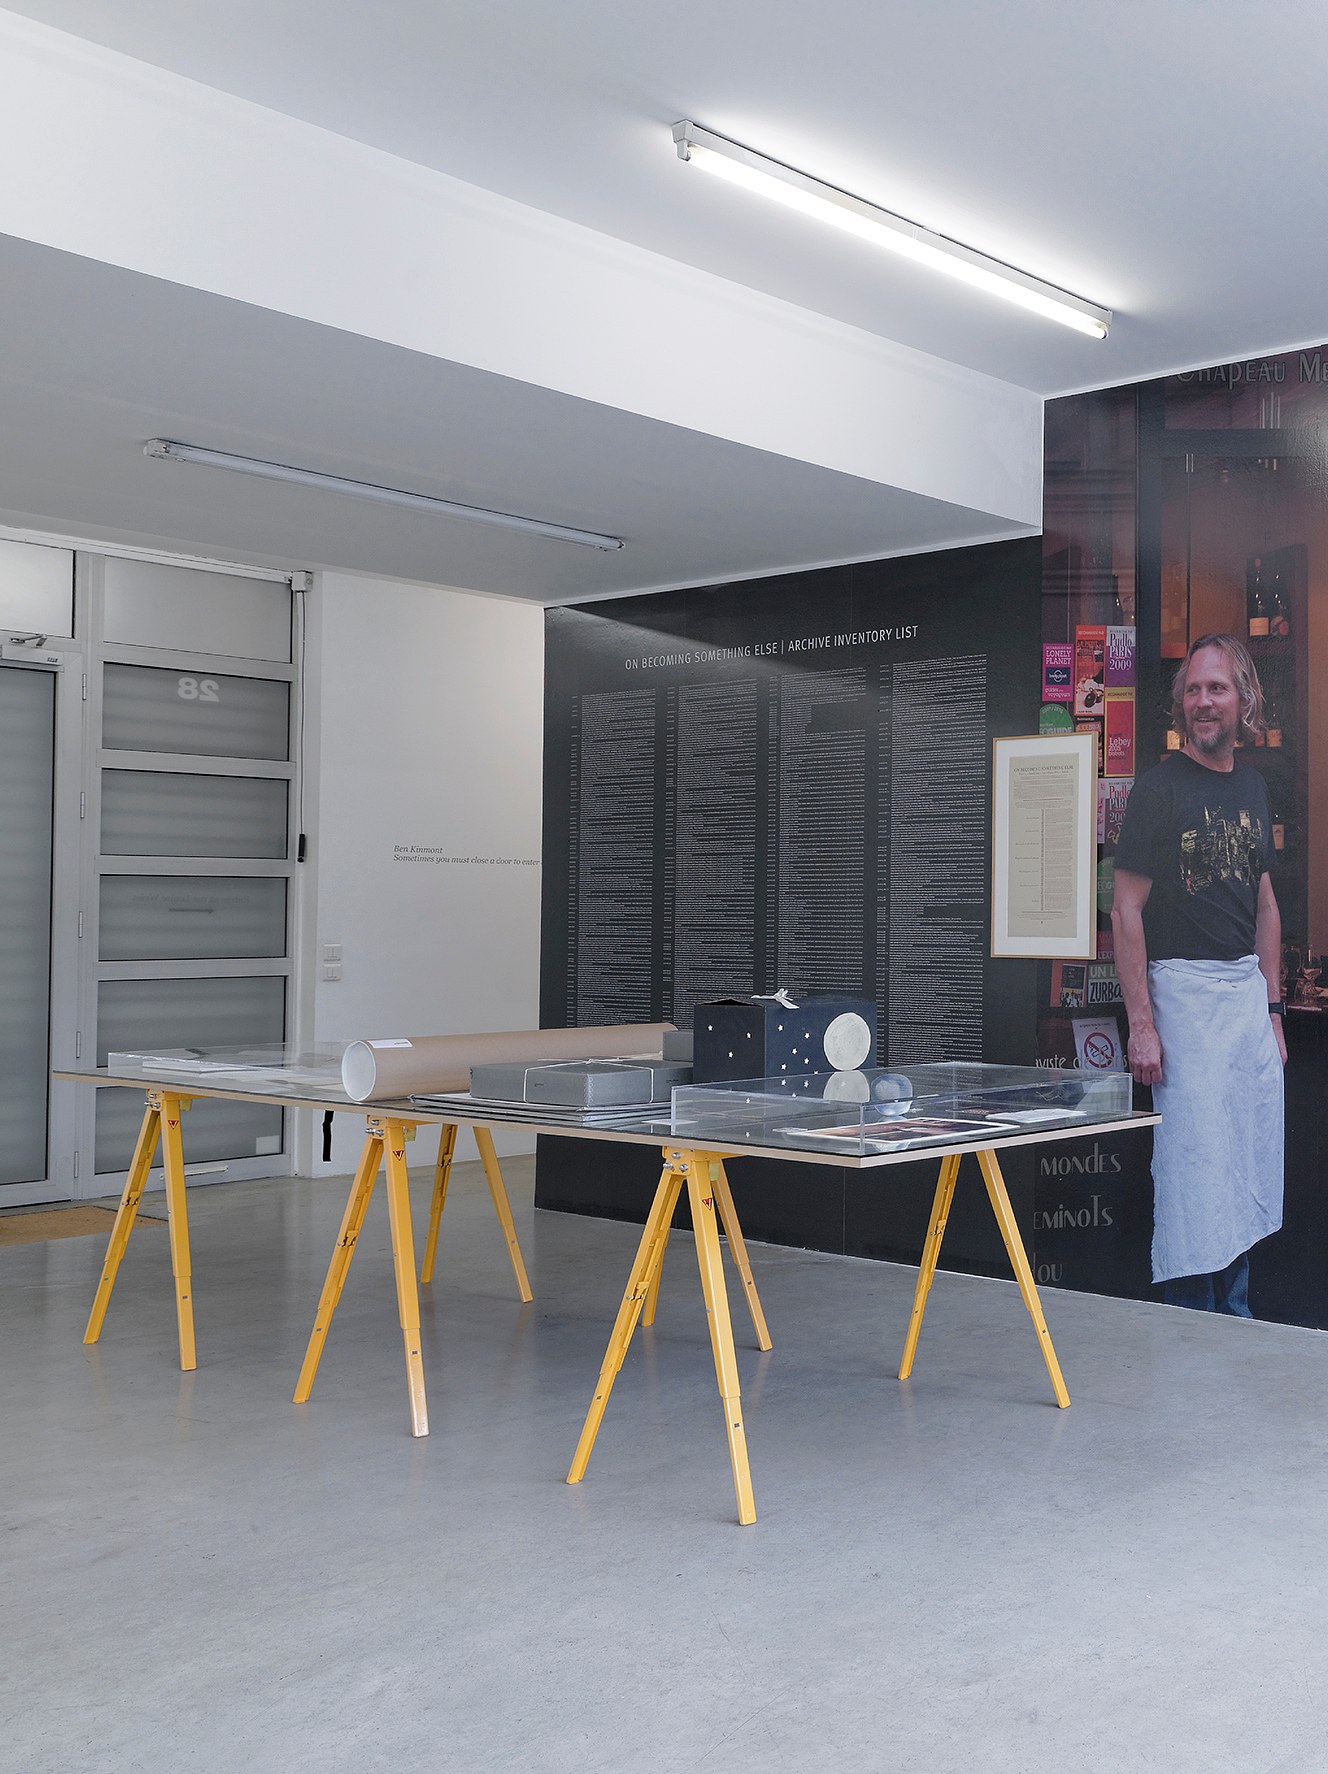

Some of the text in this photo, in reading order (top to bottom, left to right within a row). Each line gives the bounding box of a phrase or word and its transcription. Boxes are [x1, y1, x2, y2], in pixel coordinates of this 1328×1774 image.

[1110, 633, 1133, 647] Pudlo
[625, 625, 919, 670] ON BECOMING SOMETHING ELSE ARCHIVE INVENTORY LIST
[1109, 645, 1132, 658] PARIS
[1045, 657, 1071, 665] PLANET
[1109, 660, 1132, 670] 2009
[1109, 736, 1131, 747] Lebey
[393, 844, 443, 854] Ben Kinmont
[393, 854, 434, 863] Sometimes
[471, 856, 489, 864] close
[496, 857, 513, 865] door
[1089, 965, 1107, 978] UN
